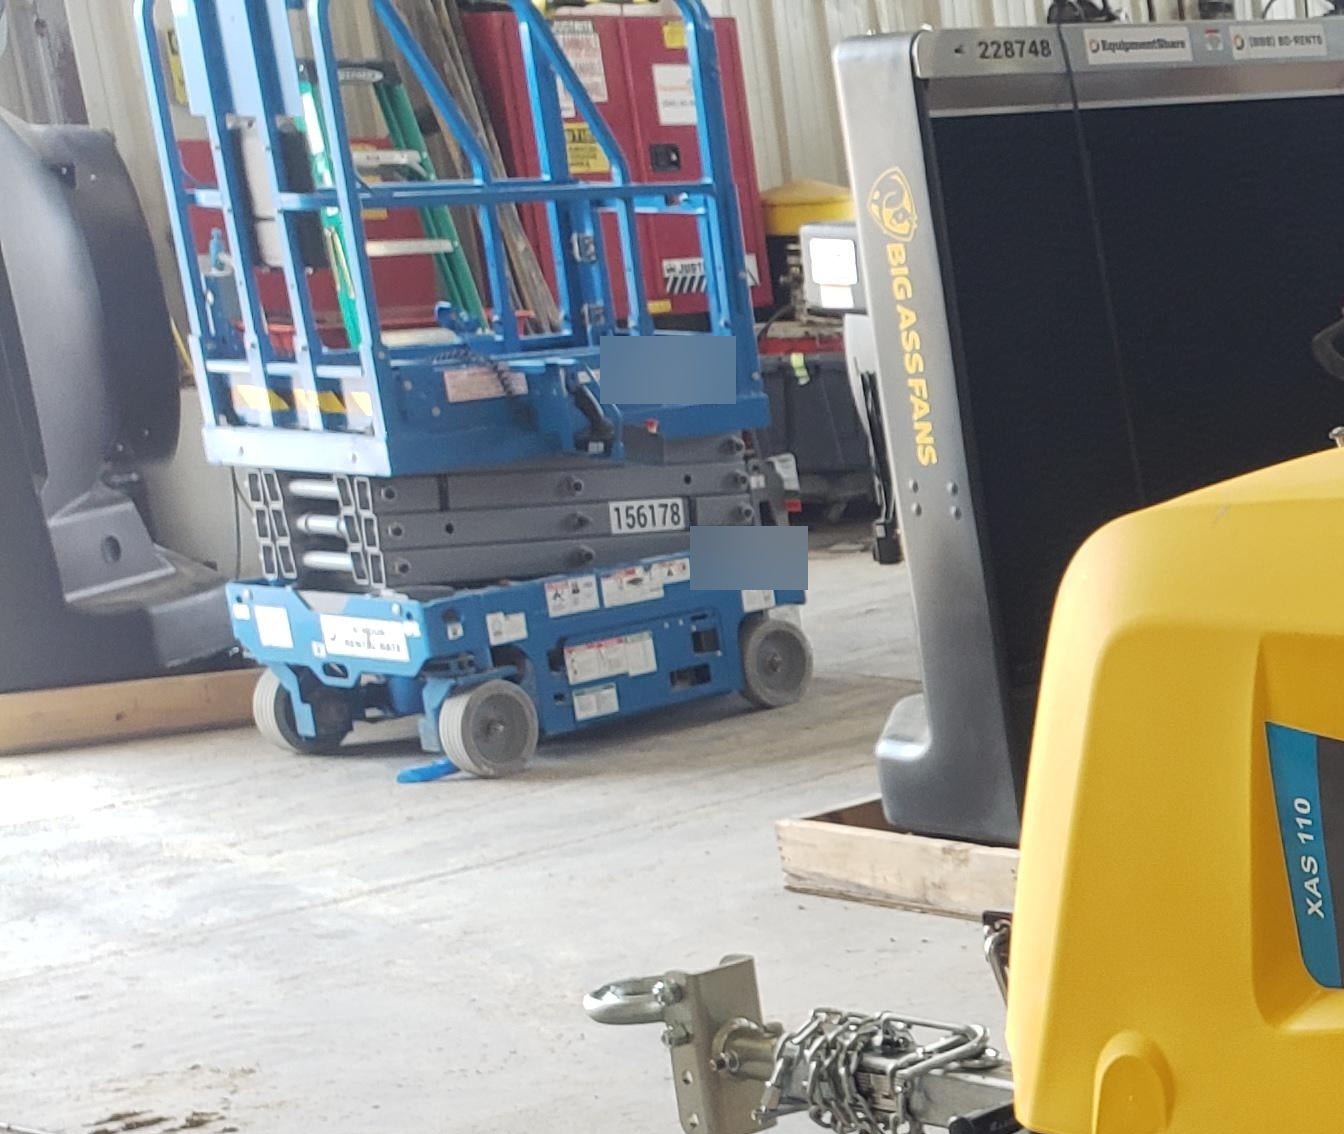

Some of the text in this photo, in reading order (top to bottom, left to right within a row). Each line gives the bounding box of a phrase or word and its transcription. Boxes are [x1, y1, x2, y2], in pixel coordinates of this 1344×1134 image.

[978, 39, 1052, 59] 228748
[1101, 38, 1186, 52] EquipmentShare
[886, 243, 938, 466] BIG ASS FANS
[613, 502, 681, 530] 156178
[1294, 797, 1325, 919] XAS 110
